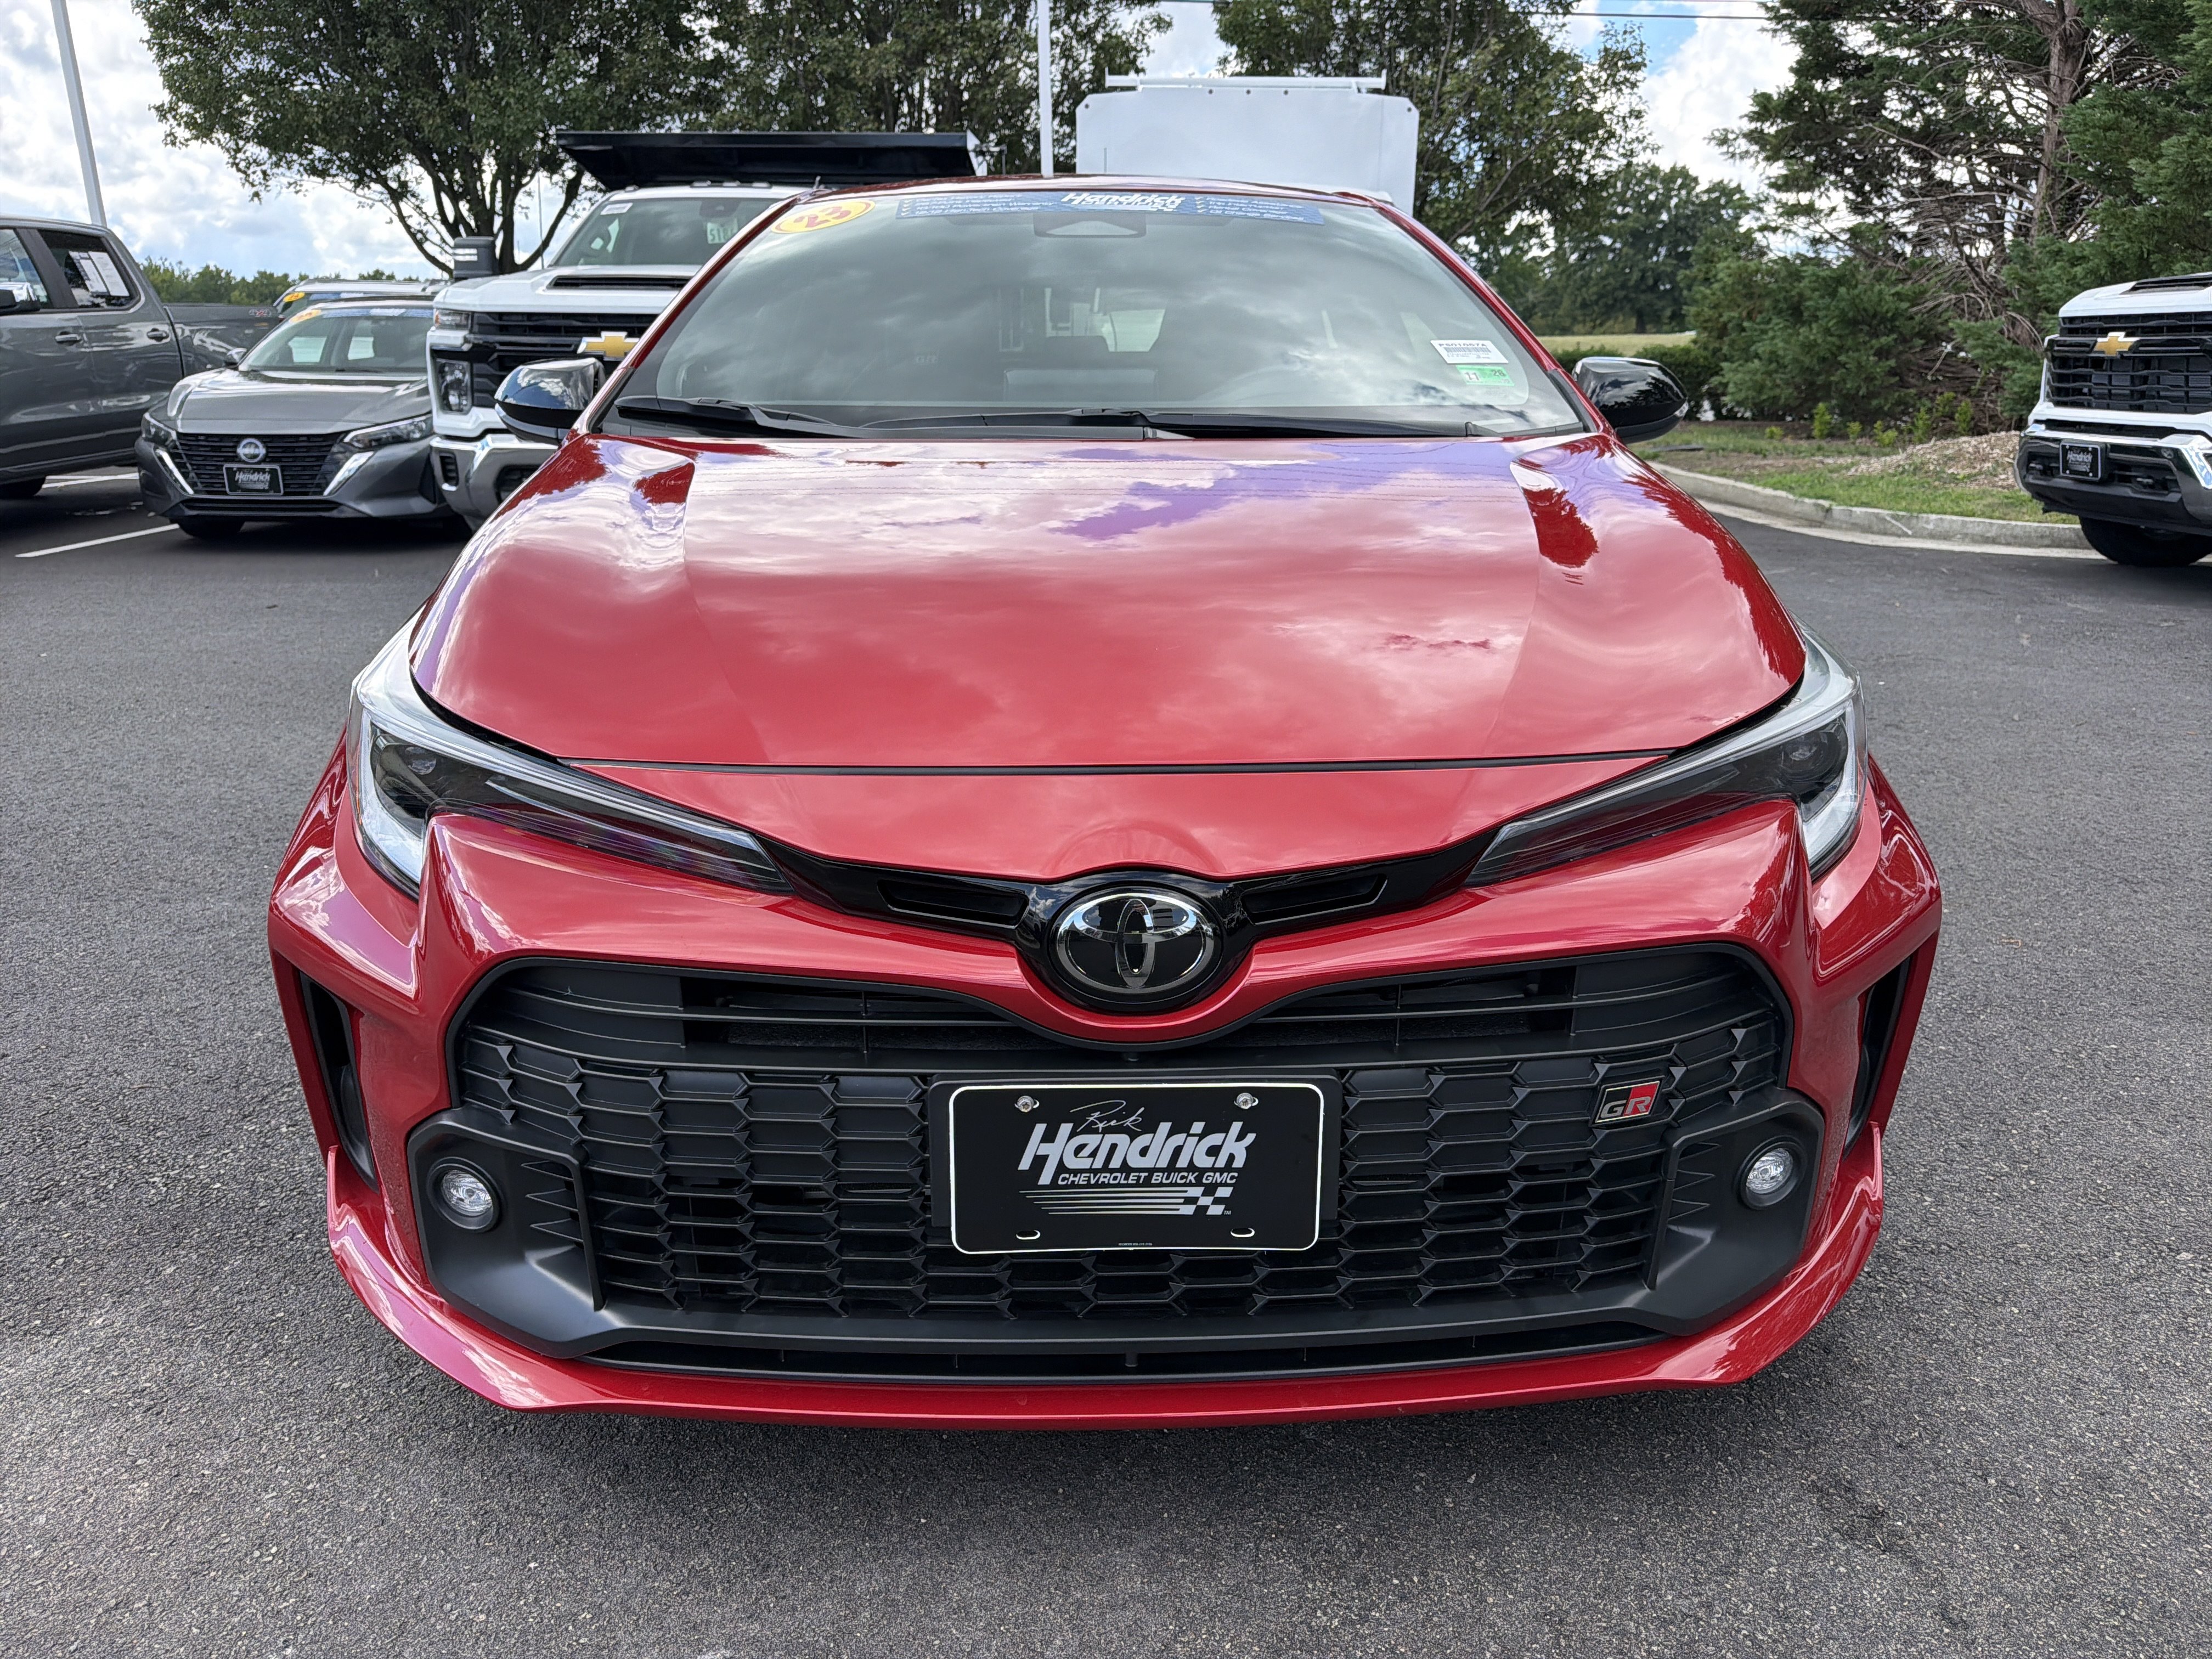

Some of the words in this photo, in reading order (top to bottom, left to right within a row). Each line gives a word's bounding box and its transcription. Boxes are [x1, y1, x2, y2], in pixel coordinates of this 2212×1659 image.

[1060, 193, 1186, 205] Hendrick
[794, 206, 851, 228] 23
[1070, 1100, 1145, 1133] Rick
[1600, 1096, 1651, 1119] GR
[1018, 1121, 1257, 1186] Hendrick
[1057, 1172, 1148, 1185] CHEVROLET
[1150, 1172, 1199, 1184] BUICK
[1202, 1172, 1238, 1184] GMC
